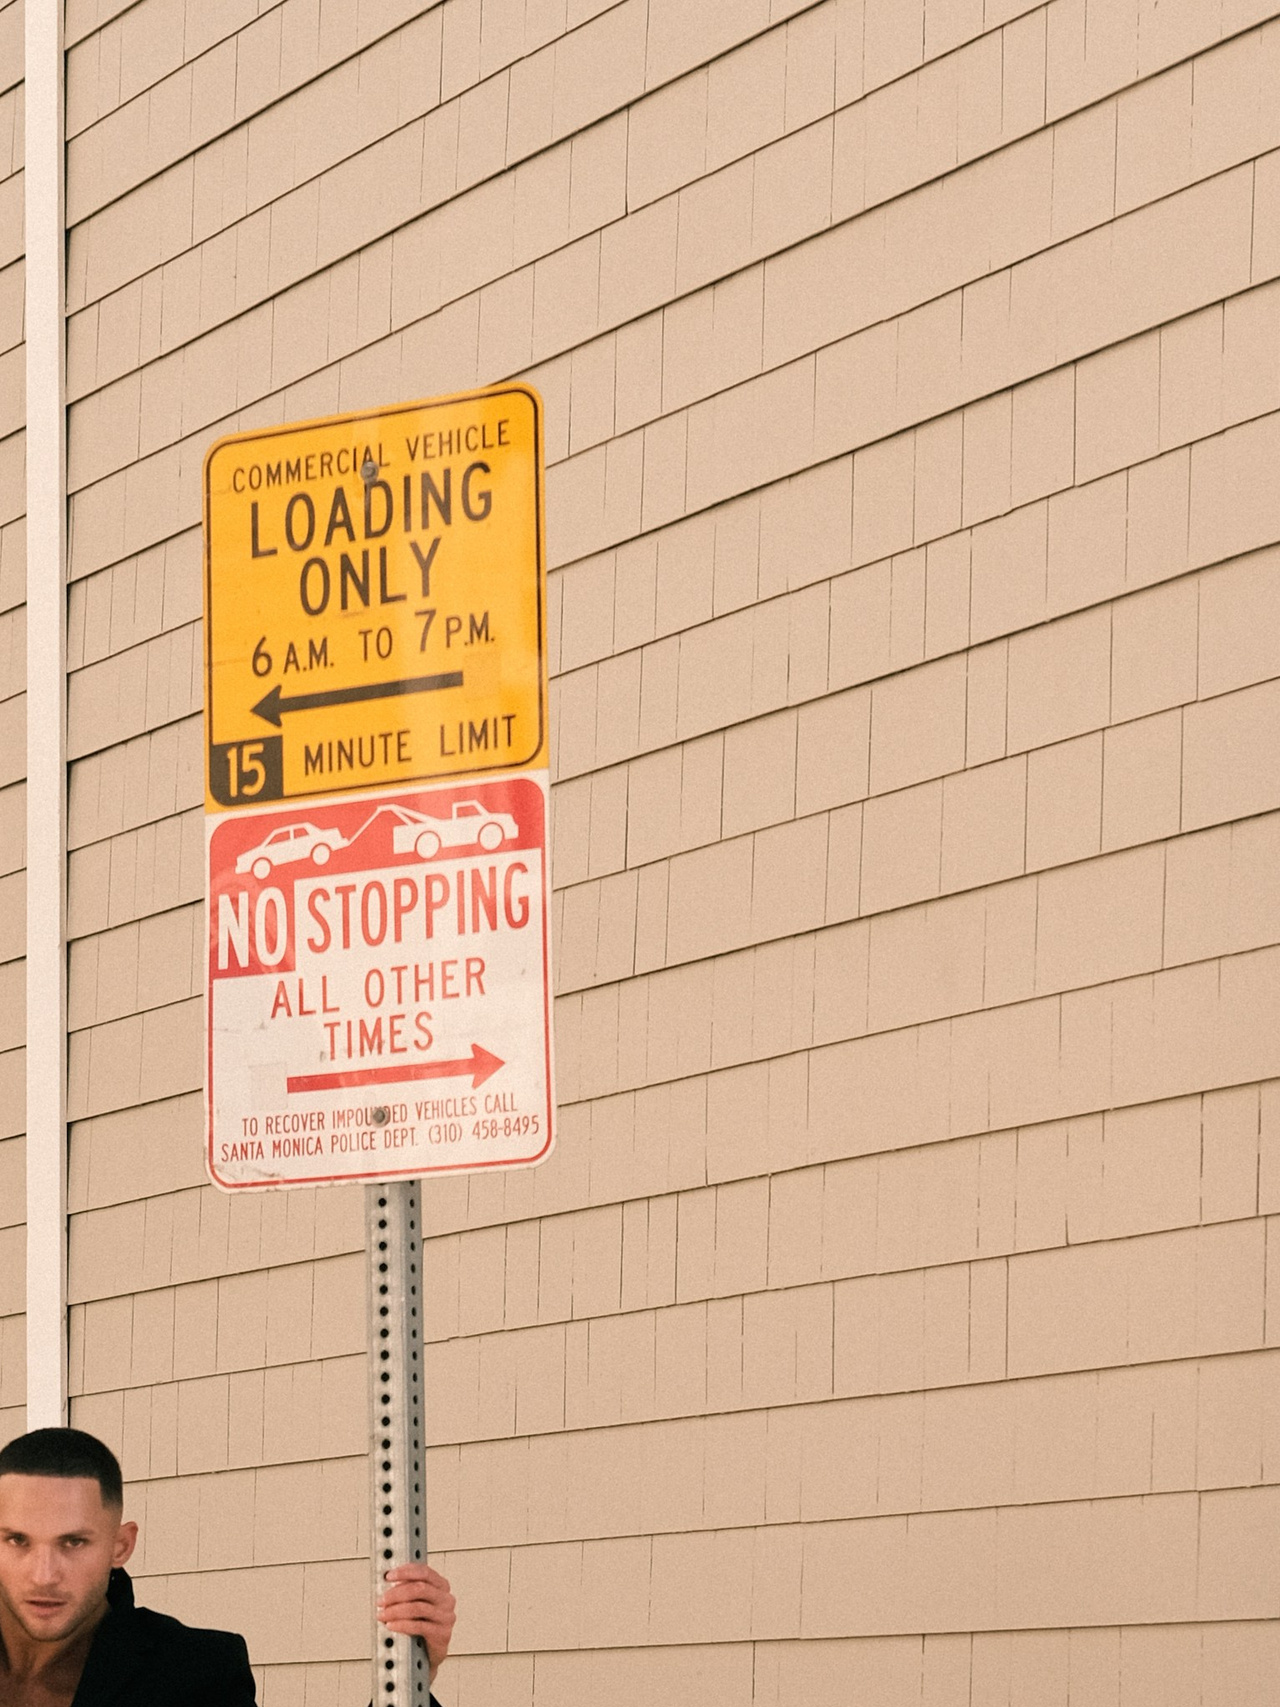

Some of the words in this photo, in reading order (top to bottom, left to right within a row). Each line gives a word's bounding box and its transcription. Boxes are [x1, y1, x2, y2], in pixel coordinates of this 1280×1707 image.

[232, 443, 390, 492] COMMERCIAL
[406, 419, 510, 460] VEHICLE
[251, 461, 491, 558] LOADING
[299, 536, 441, 616] ONLY
[252, 636, 273, 677] 6
[283, 636, 335, 675] A.M.
[358, 627, 393, 662] TO
[415, 608, 437, 652] 7
[445, 610, 495, 649] P.M.
[226, 742, 267, 798] 15
[304, 730, 412, 777] MINUTE
[440, 714, 517, 757] LIMIT
[217, 886, 288, 971] NO
[307, 862, 530, 954] STOPPING
[271, 975, 340, 1020] ALL
[364, 957, 487, 1009] OTHER
[324, 1011, 434, 1062] TIMES
[221, 1141, 265, 1162] SANTA
[272, 1136, 323, 1159] MONICA
[330, 1131, 377, 1153] POLICE
[384, 1127, 419, 1149] DEPT.
[428, 1123, 463, 1145] (310)
[472, 1115, 540, 1140] 458-8495
[242, 1117, 258, 1137] TO
[265, 1111, 325, 1135] RECOVER
[332, 1103, 408, 1128] IMPOUDED
[415, 1096, 478, 1121] VEHICLES
[484, 1092, 518, 1113] CALL
